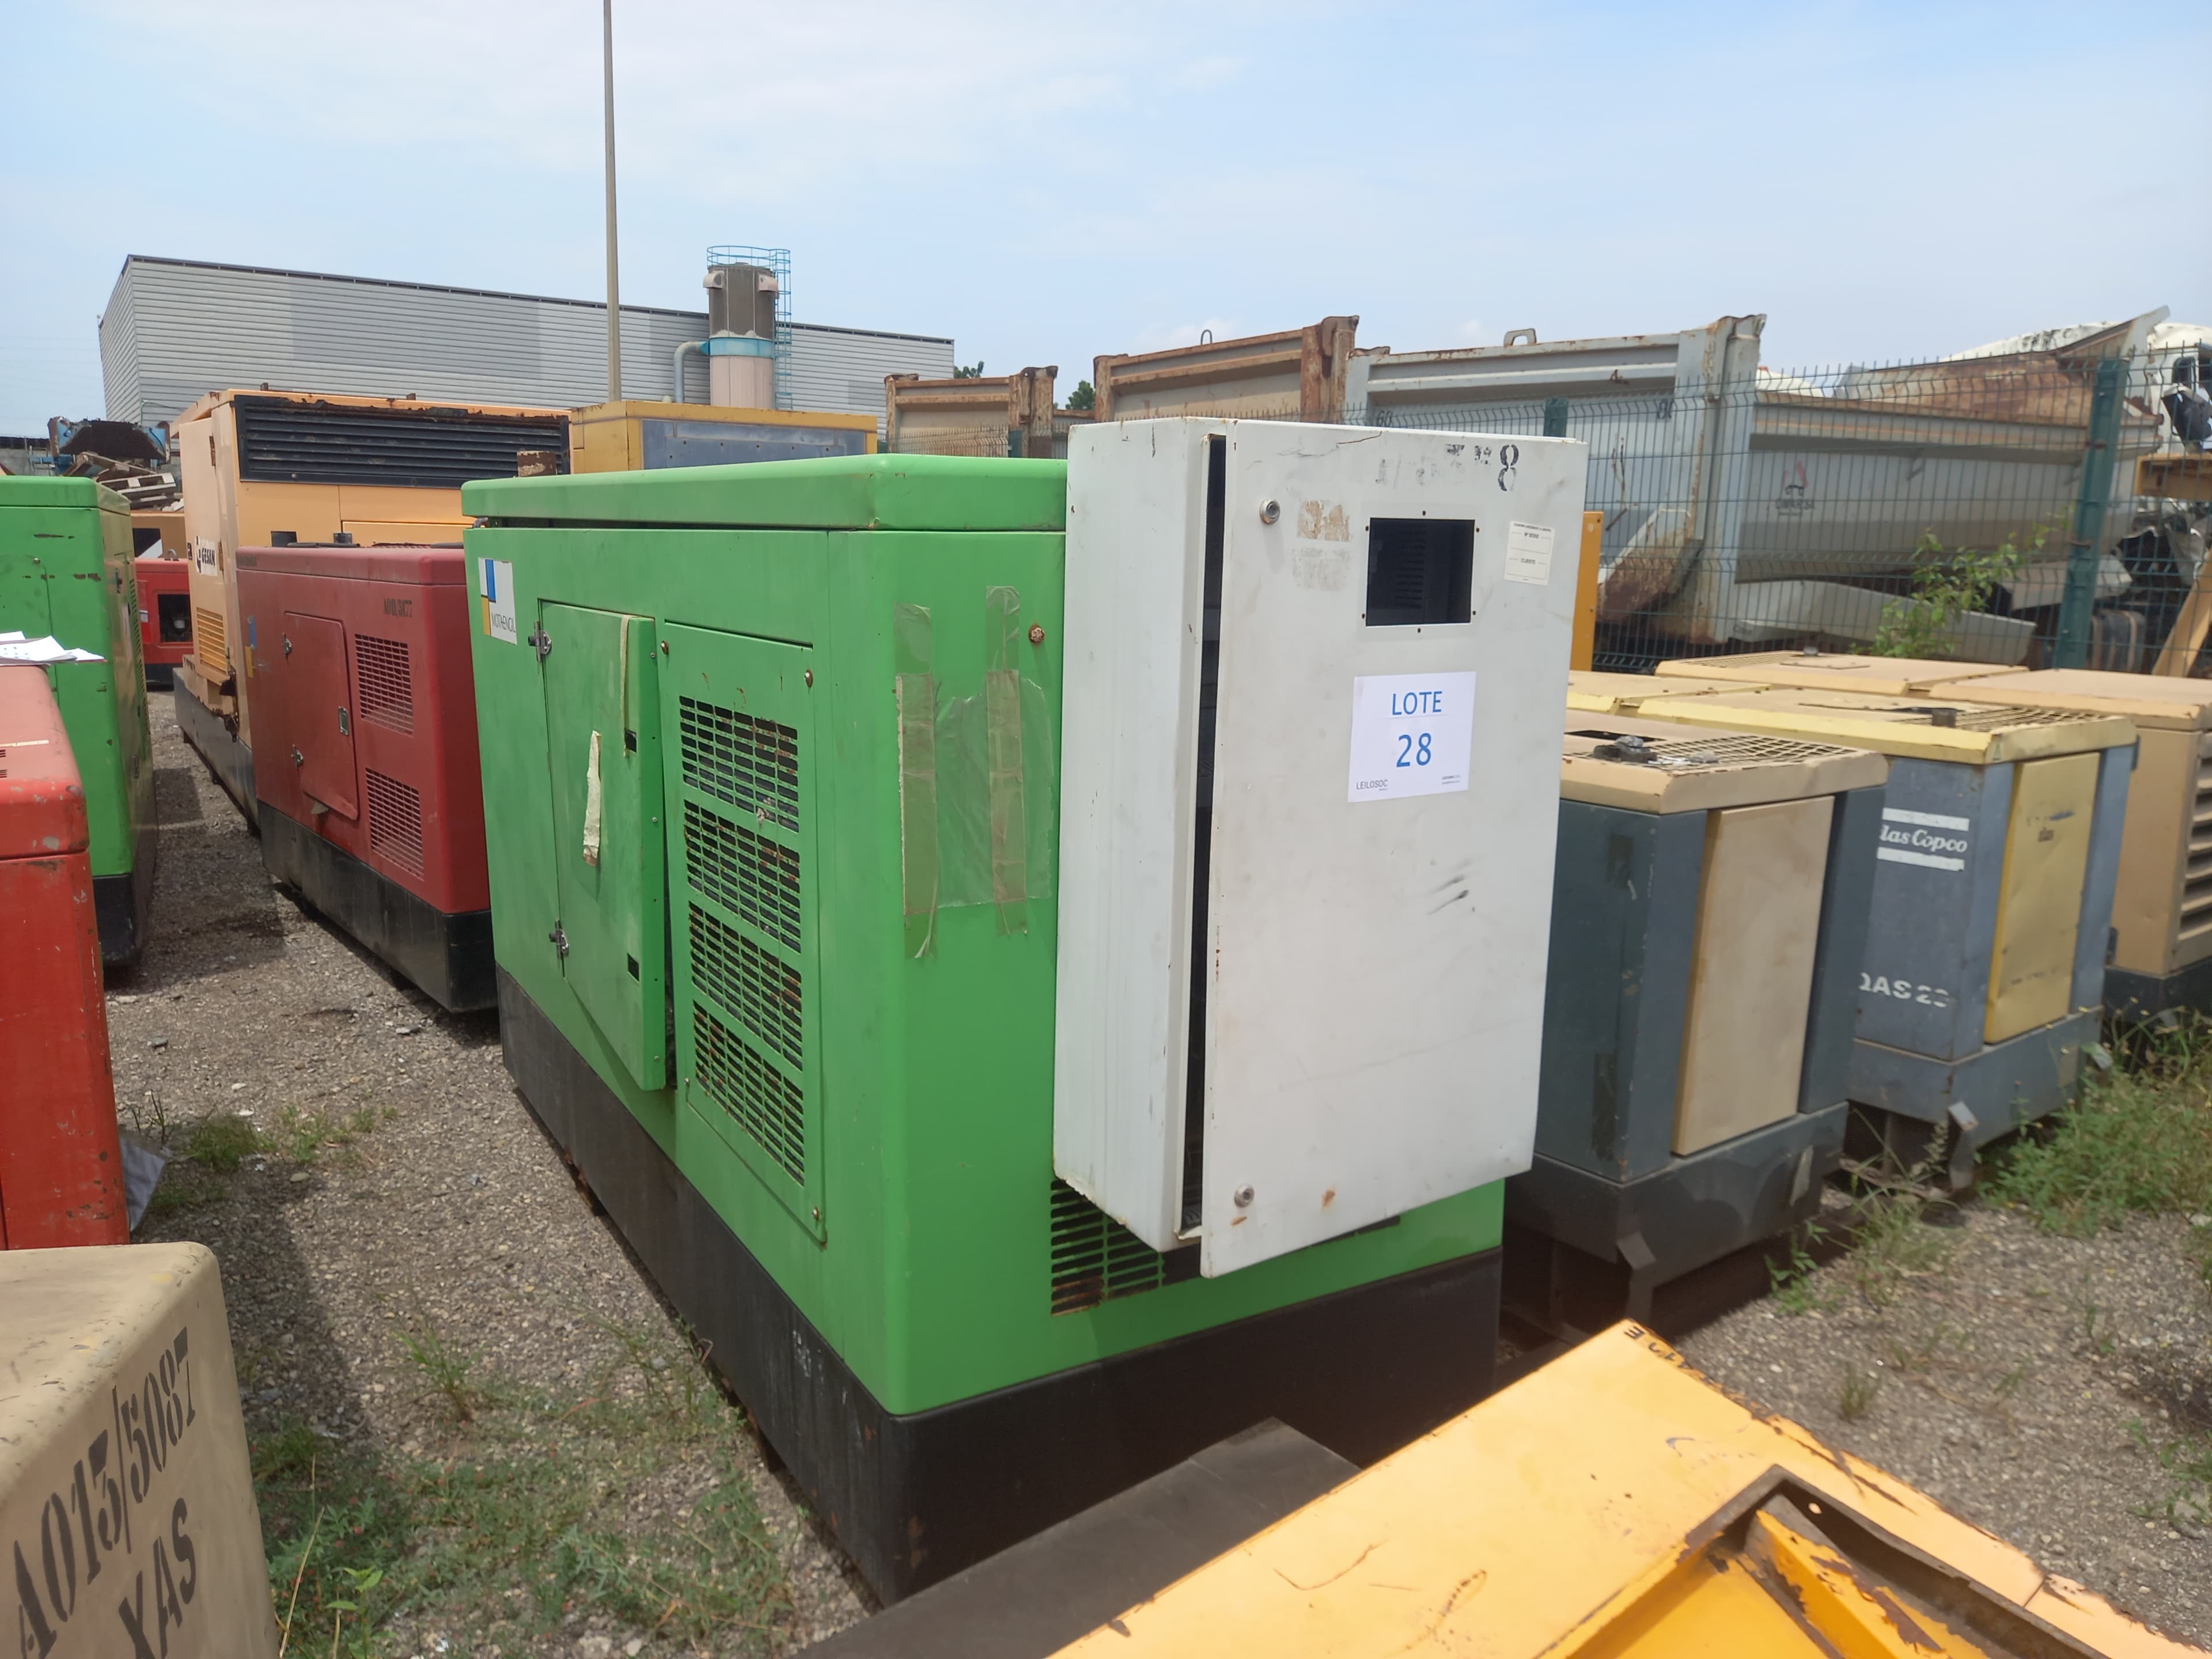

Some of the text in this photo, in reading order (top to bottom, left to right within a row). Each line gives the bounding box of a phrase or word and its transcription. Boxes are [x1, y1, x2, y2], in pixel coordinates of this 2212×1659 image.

[1392, 691, 1442, 715] LOTE
[1396, 732, 1432, 768] 28
[1356, 779, 1388, 790] LEILOSOC
[1912, 828, 1968, 853] Copco
